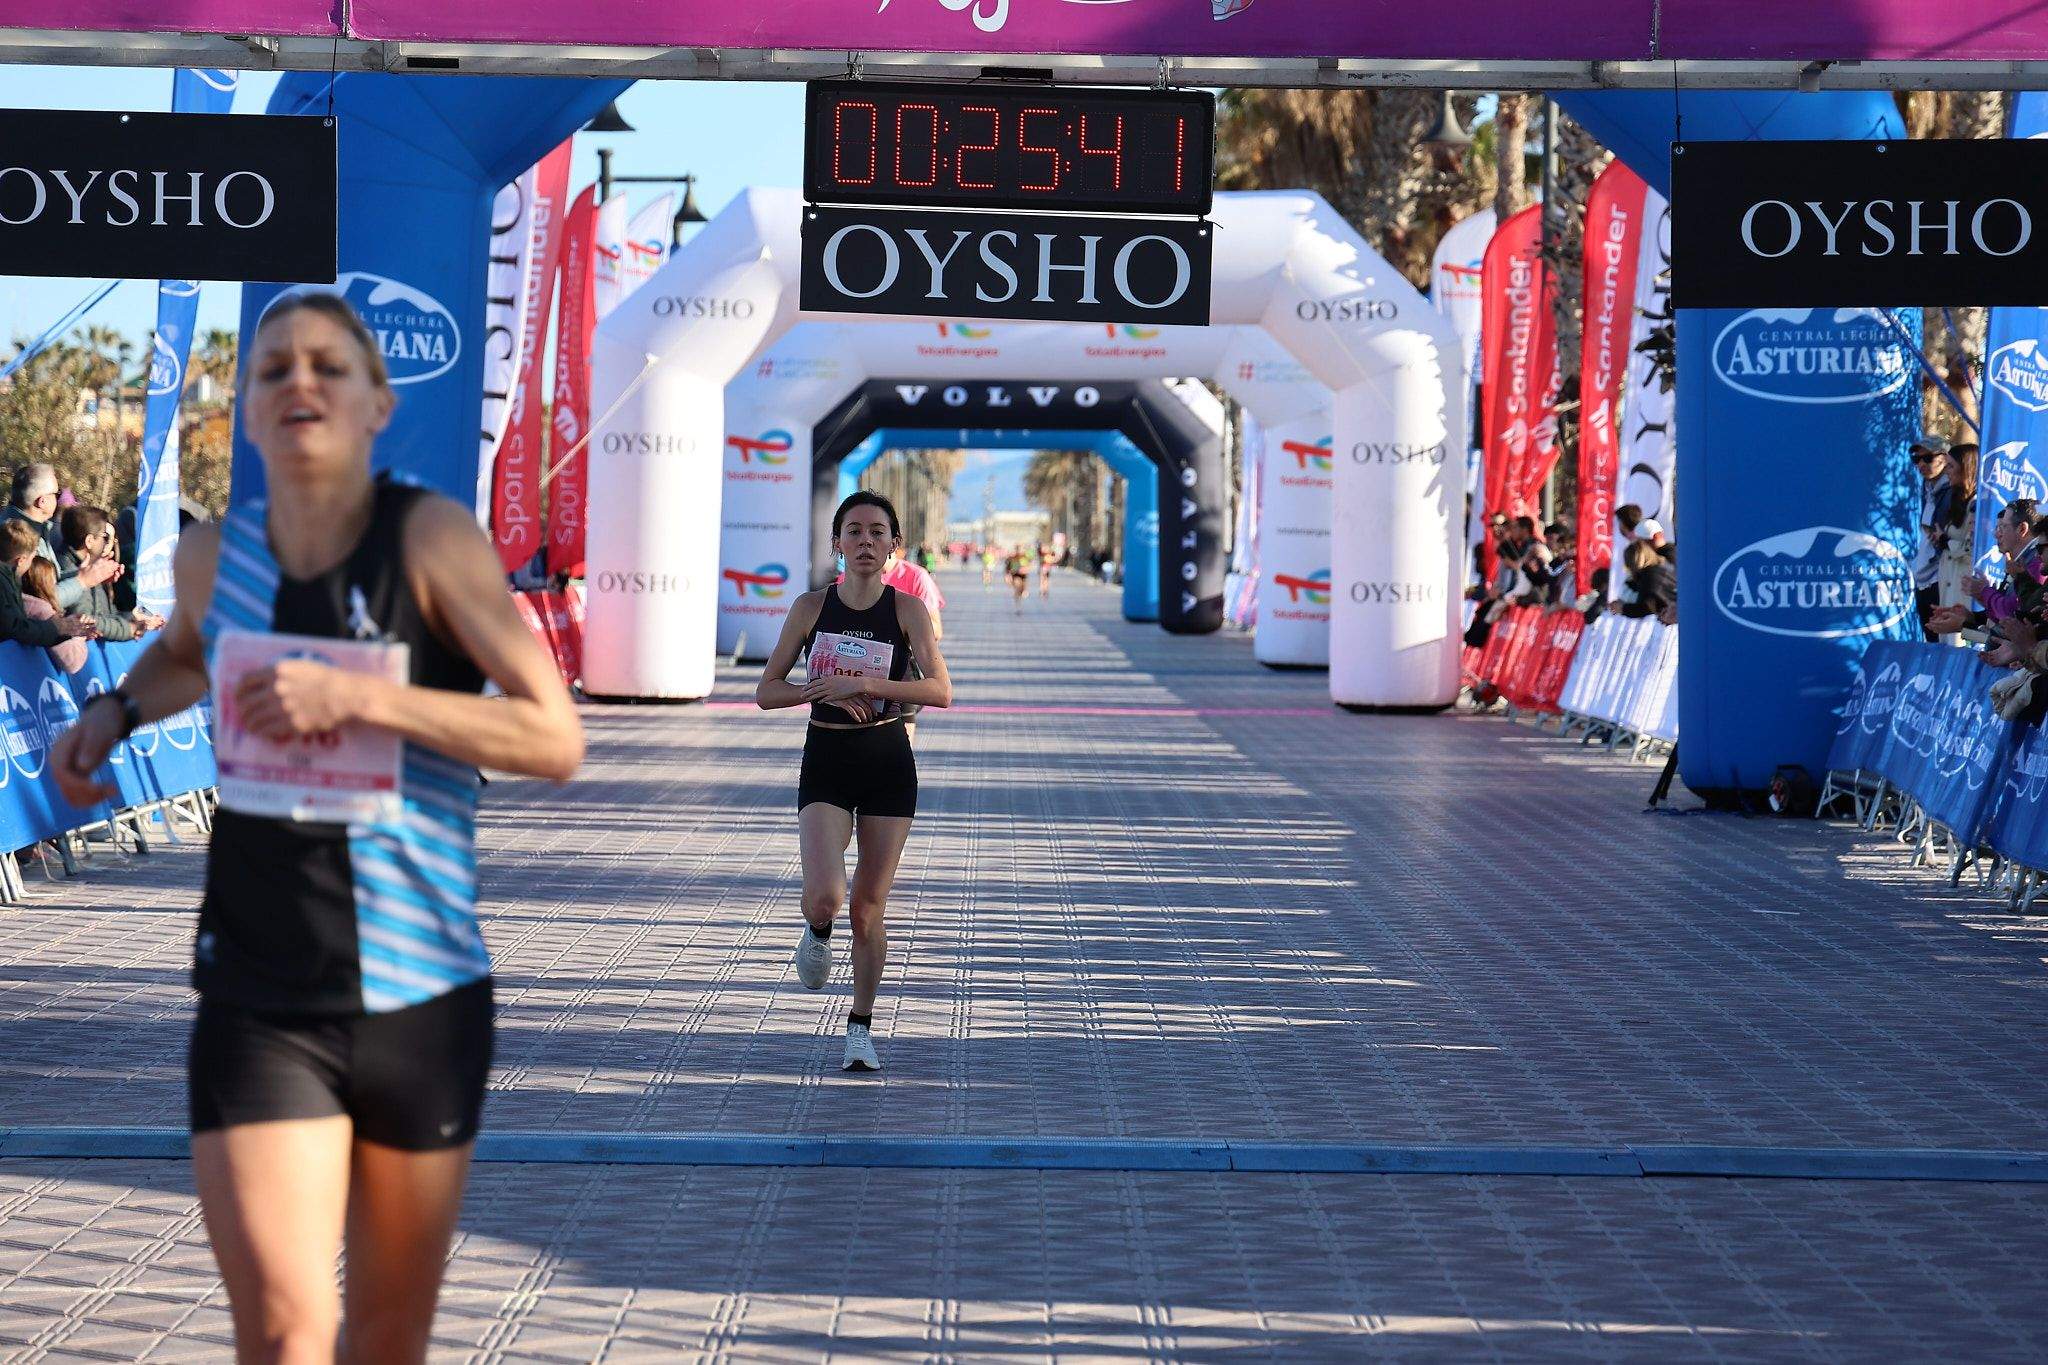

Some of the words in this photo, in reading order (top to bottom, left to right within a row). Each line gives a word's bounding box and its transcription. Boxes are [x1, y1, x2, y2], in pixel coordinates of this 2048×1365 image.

[833, 101, 1185, 192] 00:25:41
[0, 167, 275, 229] OYSHO
[1740, 198, 2032, 258] OYSHO
[822, 224, 1191, 309] OYSHO
[653, 296, 753, 319] OYSHO
[1595, 203, 1627, 391] Santander
[1297, 299, 1398, 320] OYSHO
[1505, 255, 1533, 414] Santander
[1758, 330, 1834, 342] CENTRAL
[1726, 334, 1903, 375] ASTURIANA
[895, 384, 1100, 407] VOLVO
[603, 432, 697, 454] OYSHO
[1352, 442, 1446, 465] OYSHO
[1181, 467, 1198, 613] VOLVO
[598, 570, 691, 593] OYSHO
[1760, 564, 1834, 576] CENTRAL
[1351, 581, 1443, 603] OYSHO
[1727, 567, 1904, 609] ASTURIANA
[842, 630, 874, 639] OYSHO
